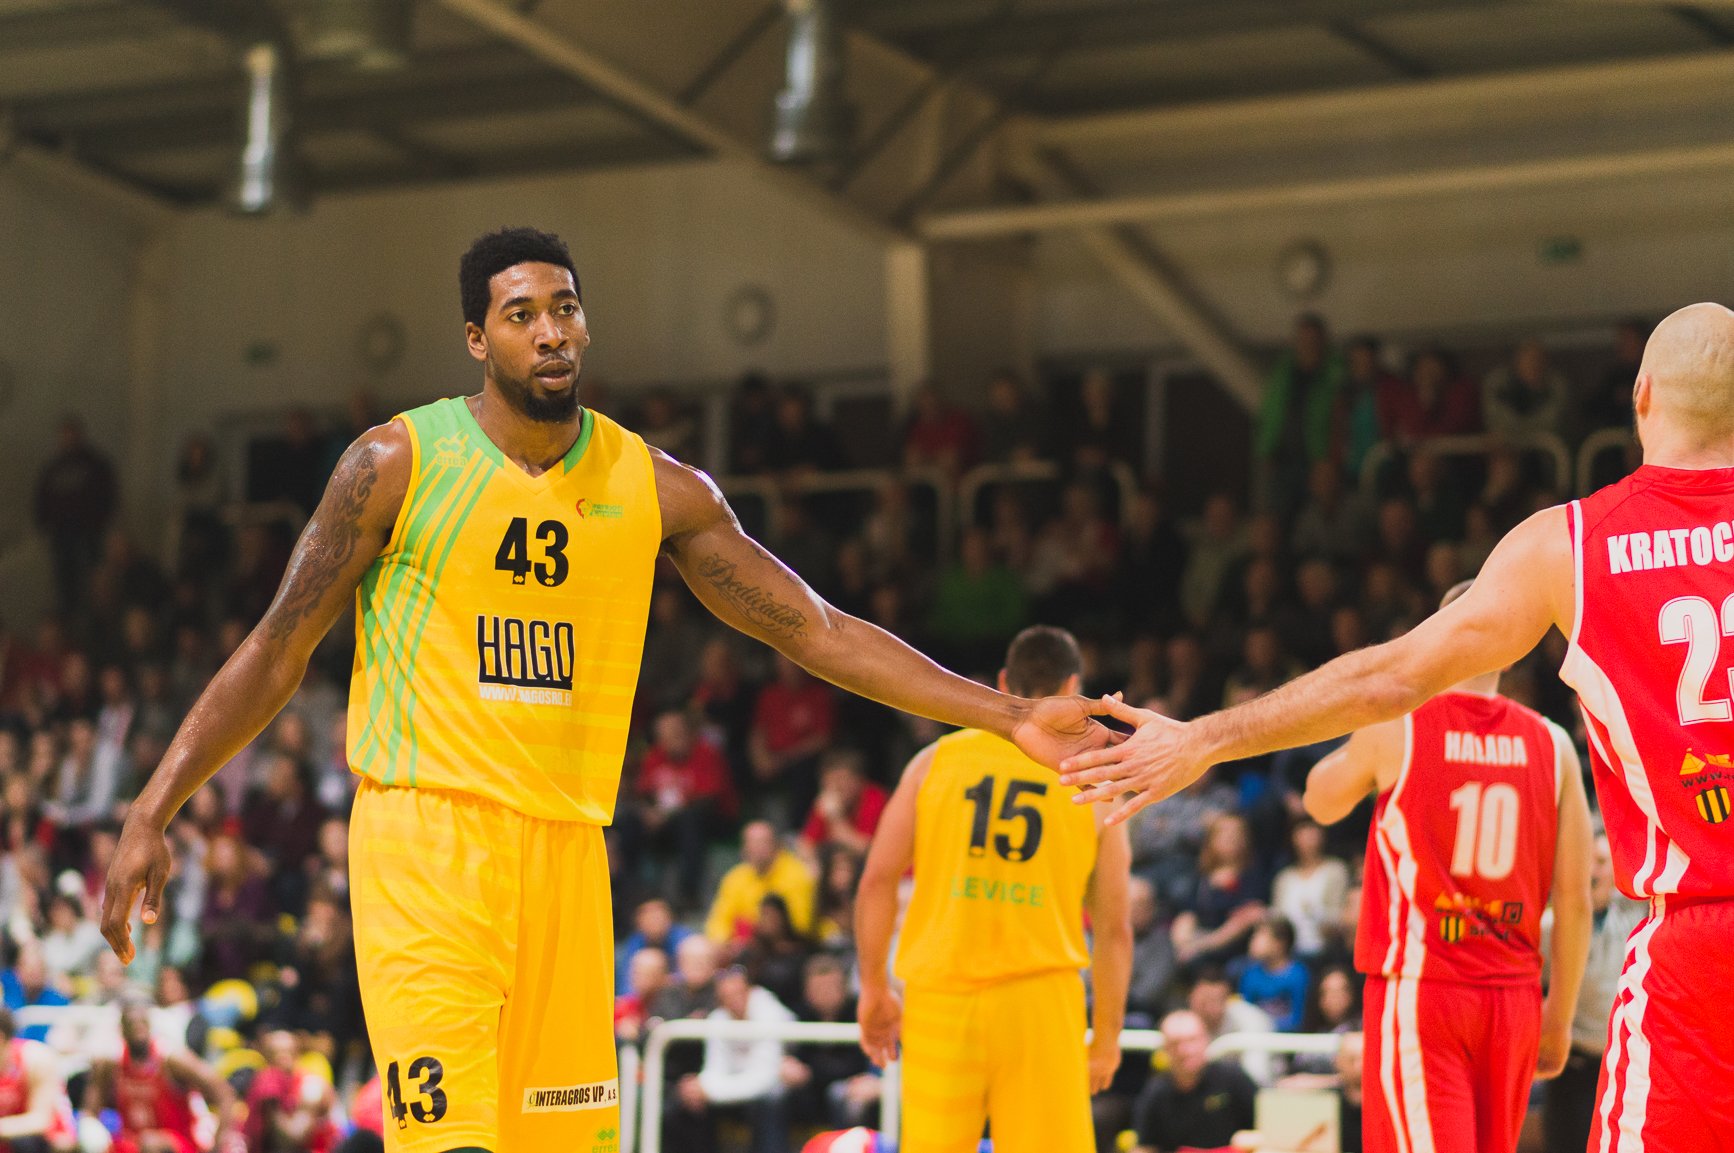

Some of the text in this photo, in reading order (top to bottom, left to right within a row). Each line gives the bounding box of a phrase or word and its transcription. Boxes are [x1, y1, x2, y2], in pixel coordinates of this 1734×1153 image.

[495, 517, 569, 587] 43
[1607, 521, 1734, 575] KRATOC
[477, 614, 575, 690] HAGO
[1658, 592, 1734, 727] 2
[965, 775, 1048, 863] 15
[1449, 780, 1519, 880] 10
[951, 876, 1044, 908] LEVICE
[387, 1056, 448, 1130] 43
[535, 1086, 590, 1107] INTERAGROS
